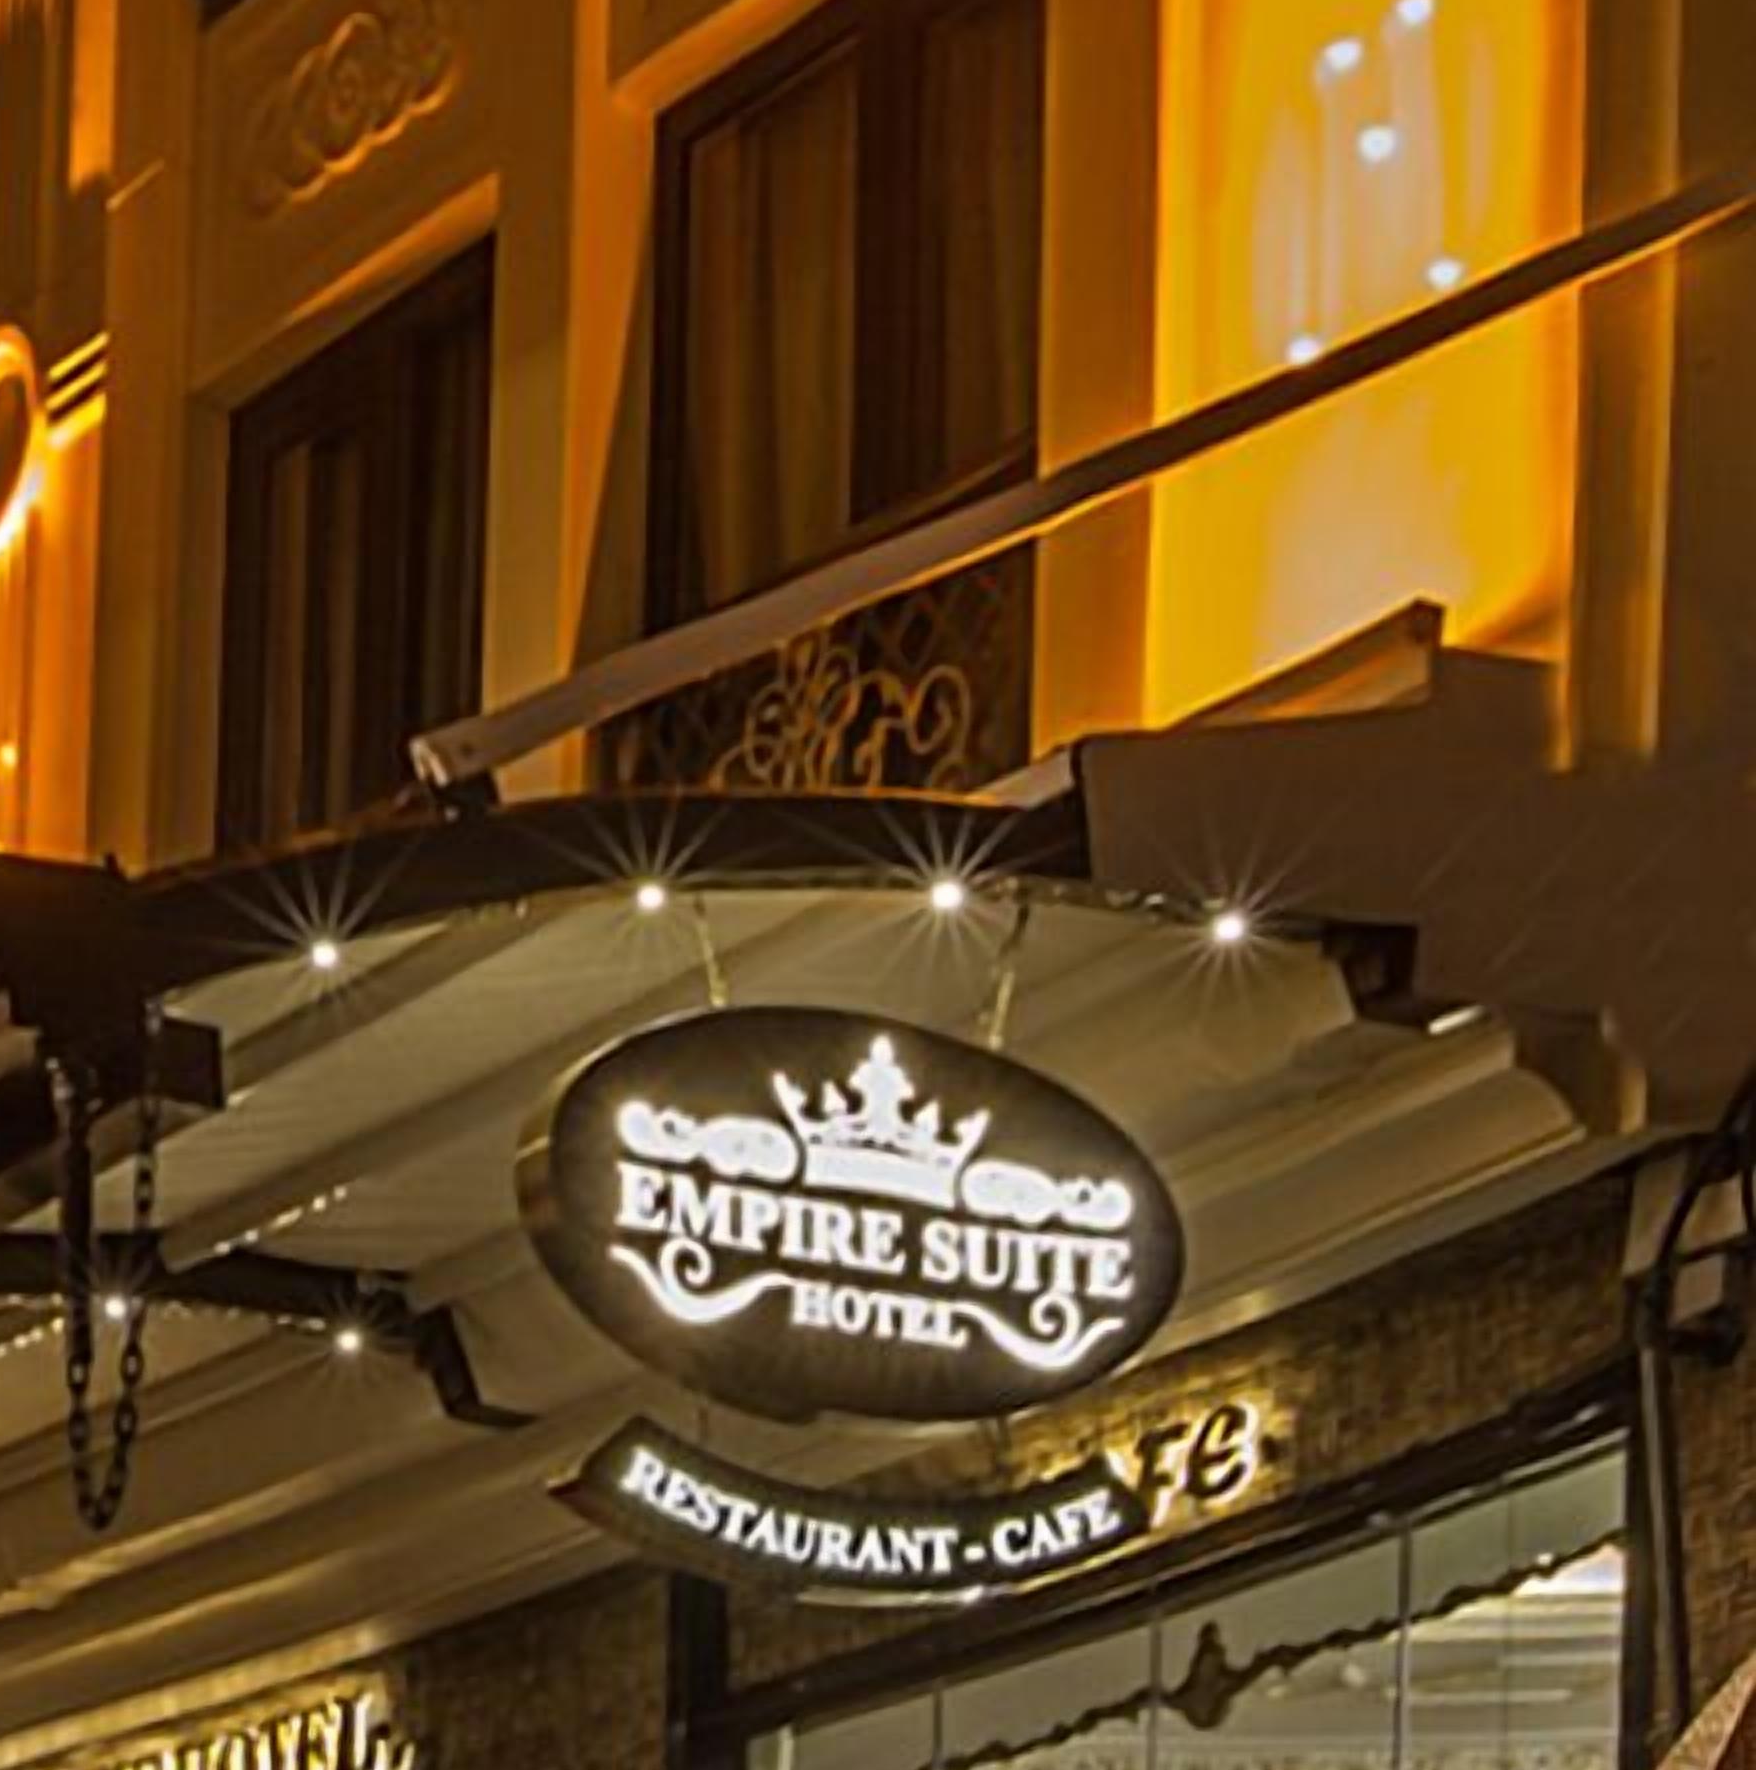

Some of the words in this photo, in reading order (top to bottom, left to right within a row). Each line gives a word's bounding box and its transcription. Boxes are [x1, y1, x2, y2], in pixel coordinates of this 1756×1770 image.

[613, 1160, 905, 1273] EMPIRE
[920, 1218, 1135, 1299] SUITE
[790, 1279, 969, 1350] HOTEL
[619, 1445, 958, 1573] RESTAURANT
[991, 1488, 1121, 1566] CAFE
